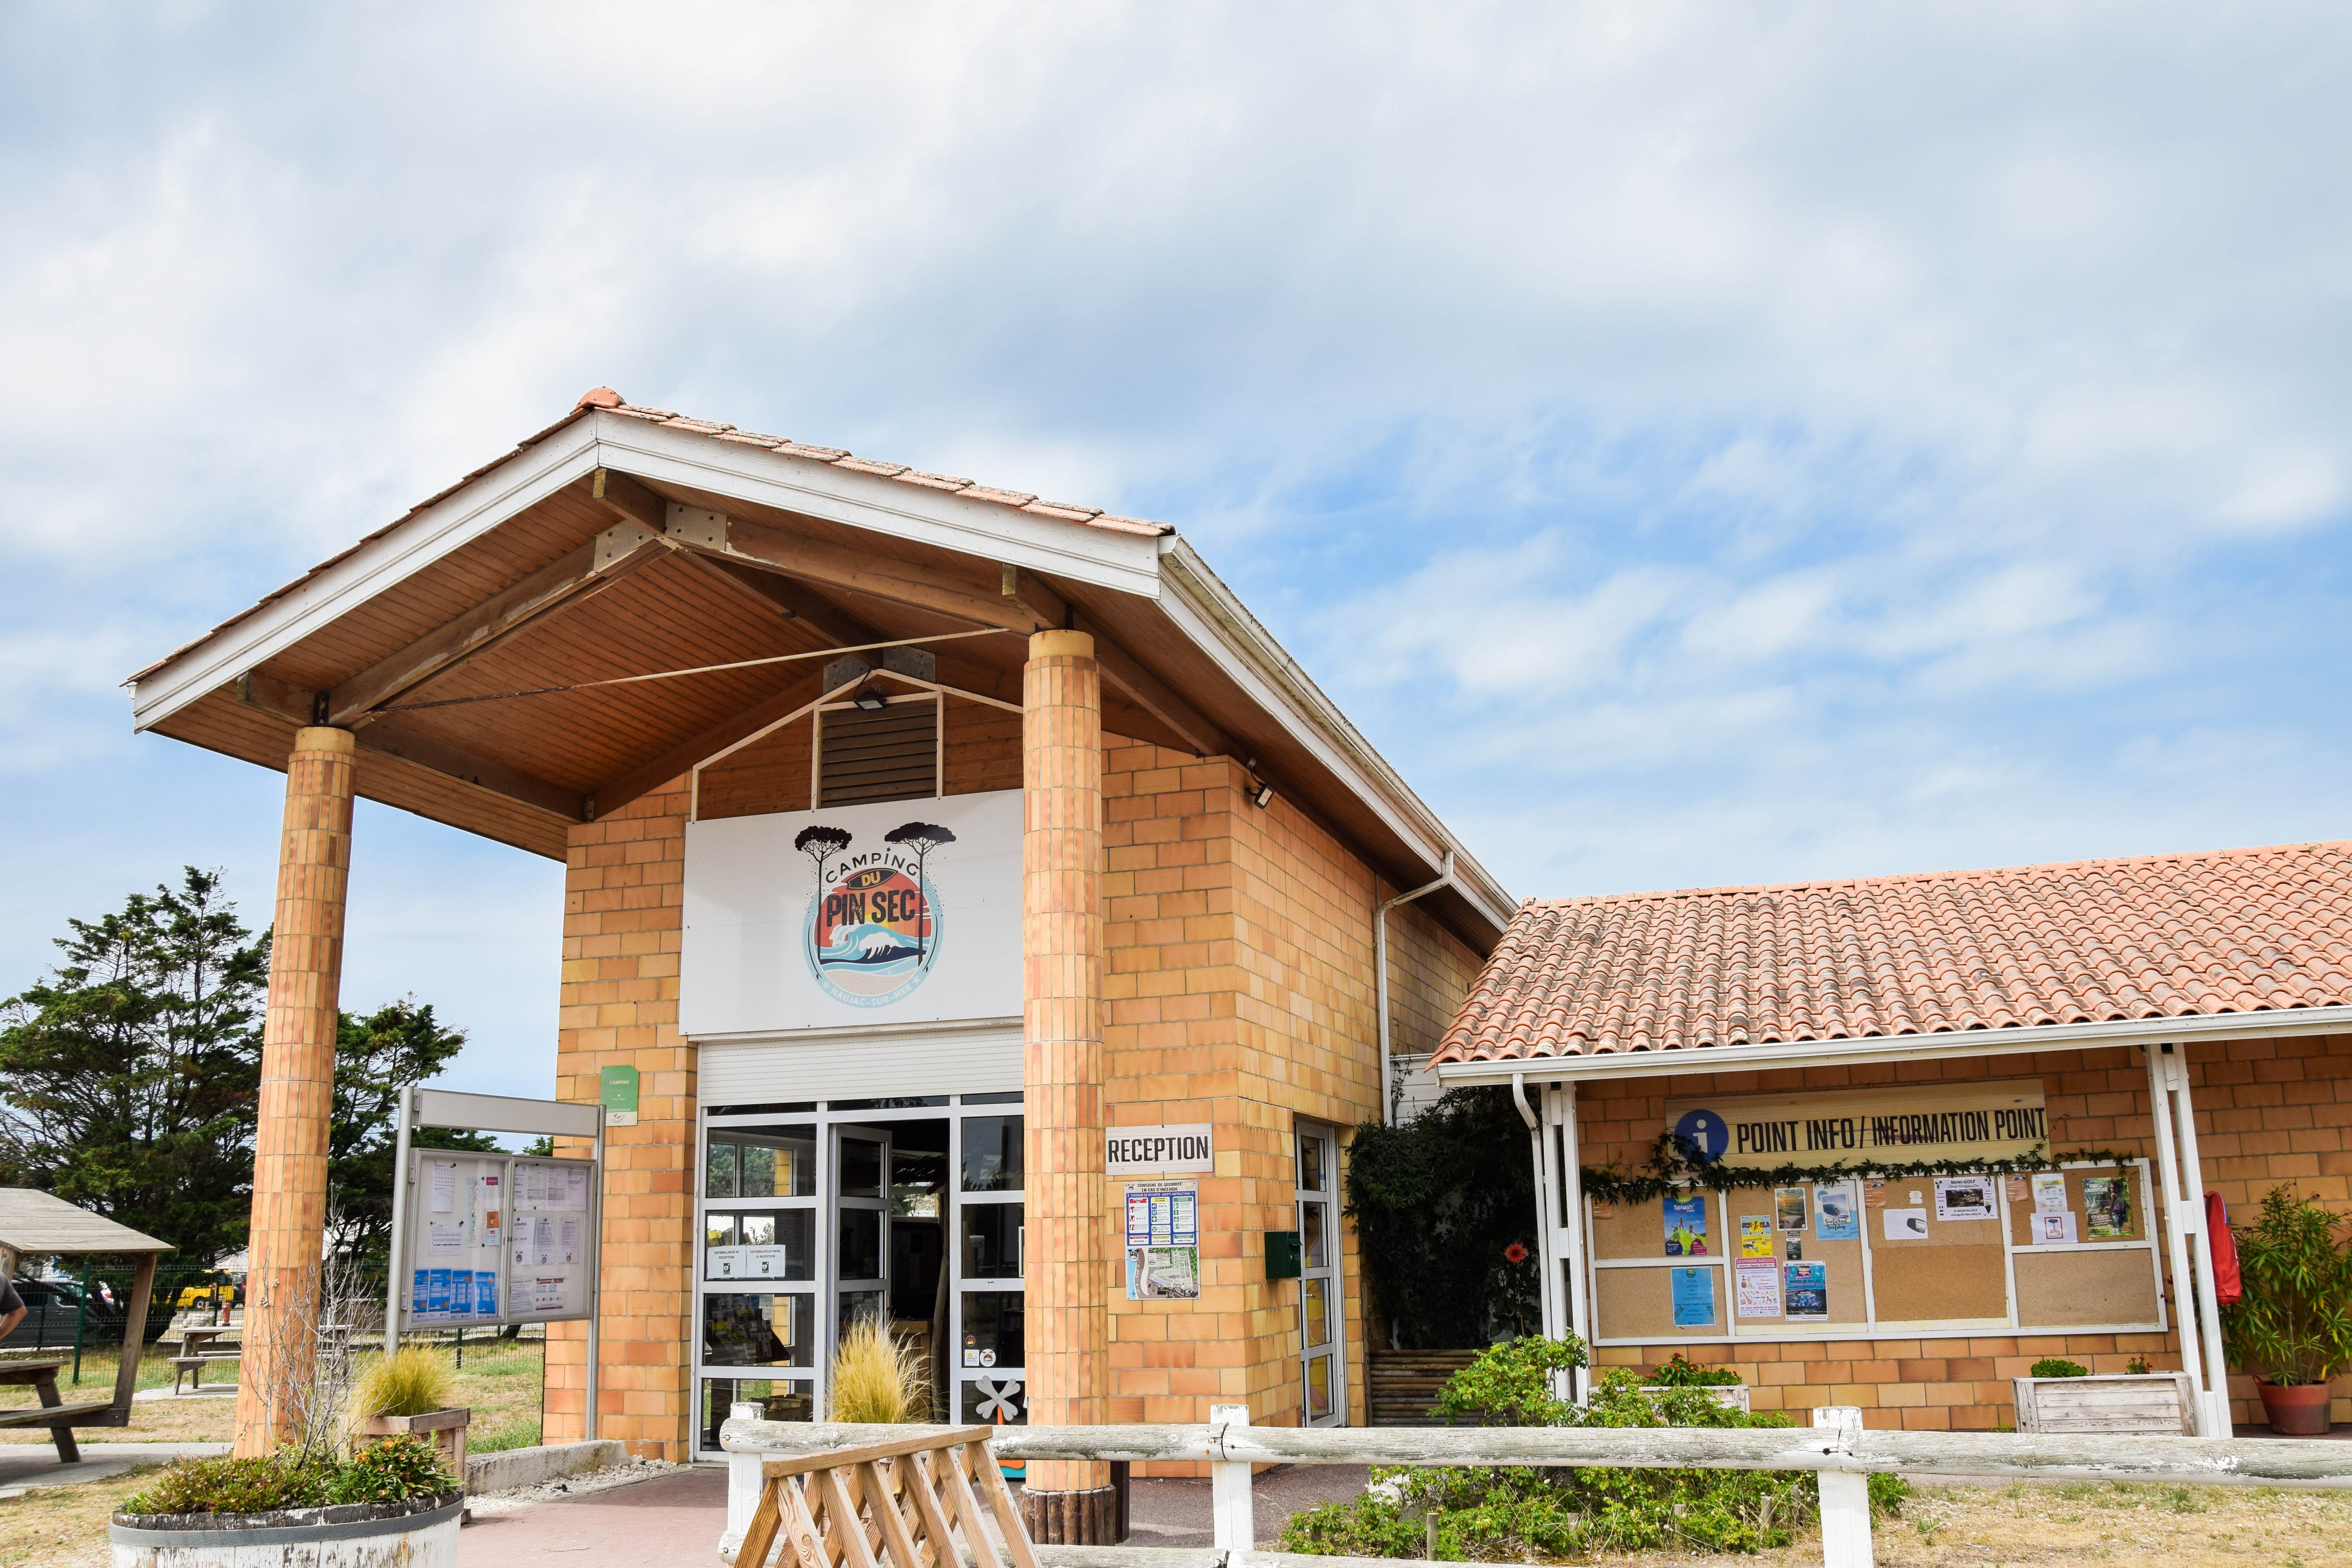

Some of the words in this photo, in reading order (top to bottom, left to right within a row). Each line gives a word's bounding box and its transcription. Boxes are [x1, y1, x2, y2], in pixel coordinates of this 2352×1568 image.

[826, 848, 919, 883] CAMPING
[861, 871, 881, 887] DU
[827, 892, 865, 927] PIN
[871, 889, 915, 923] SEC
[830, 984, 912, 1006] NAUJAC-SUR-MER
[1737, 1121, 1799, 1153] POINT
[1994, 1108, 2045, 1140] POINT
[1108, 1136, 1209, 1163] RECEPTION
